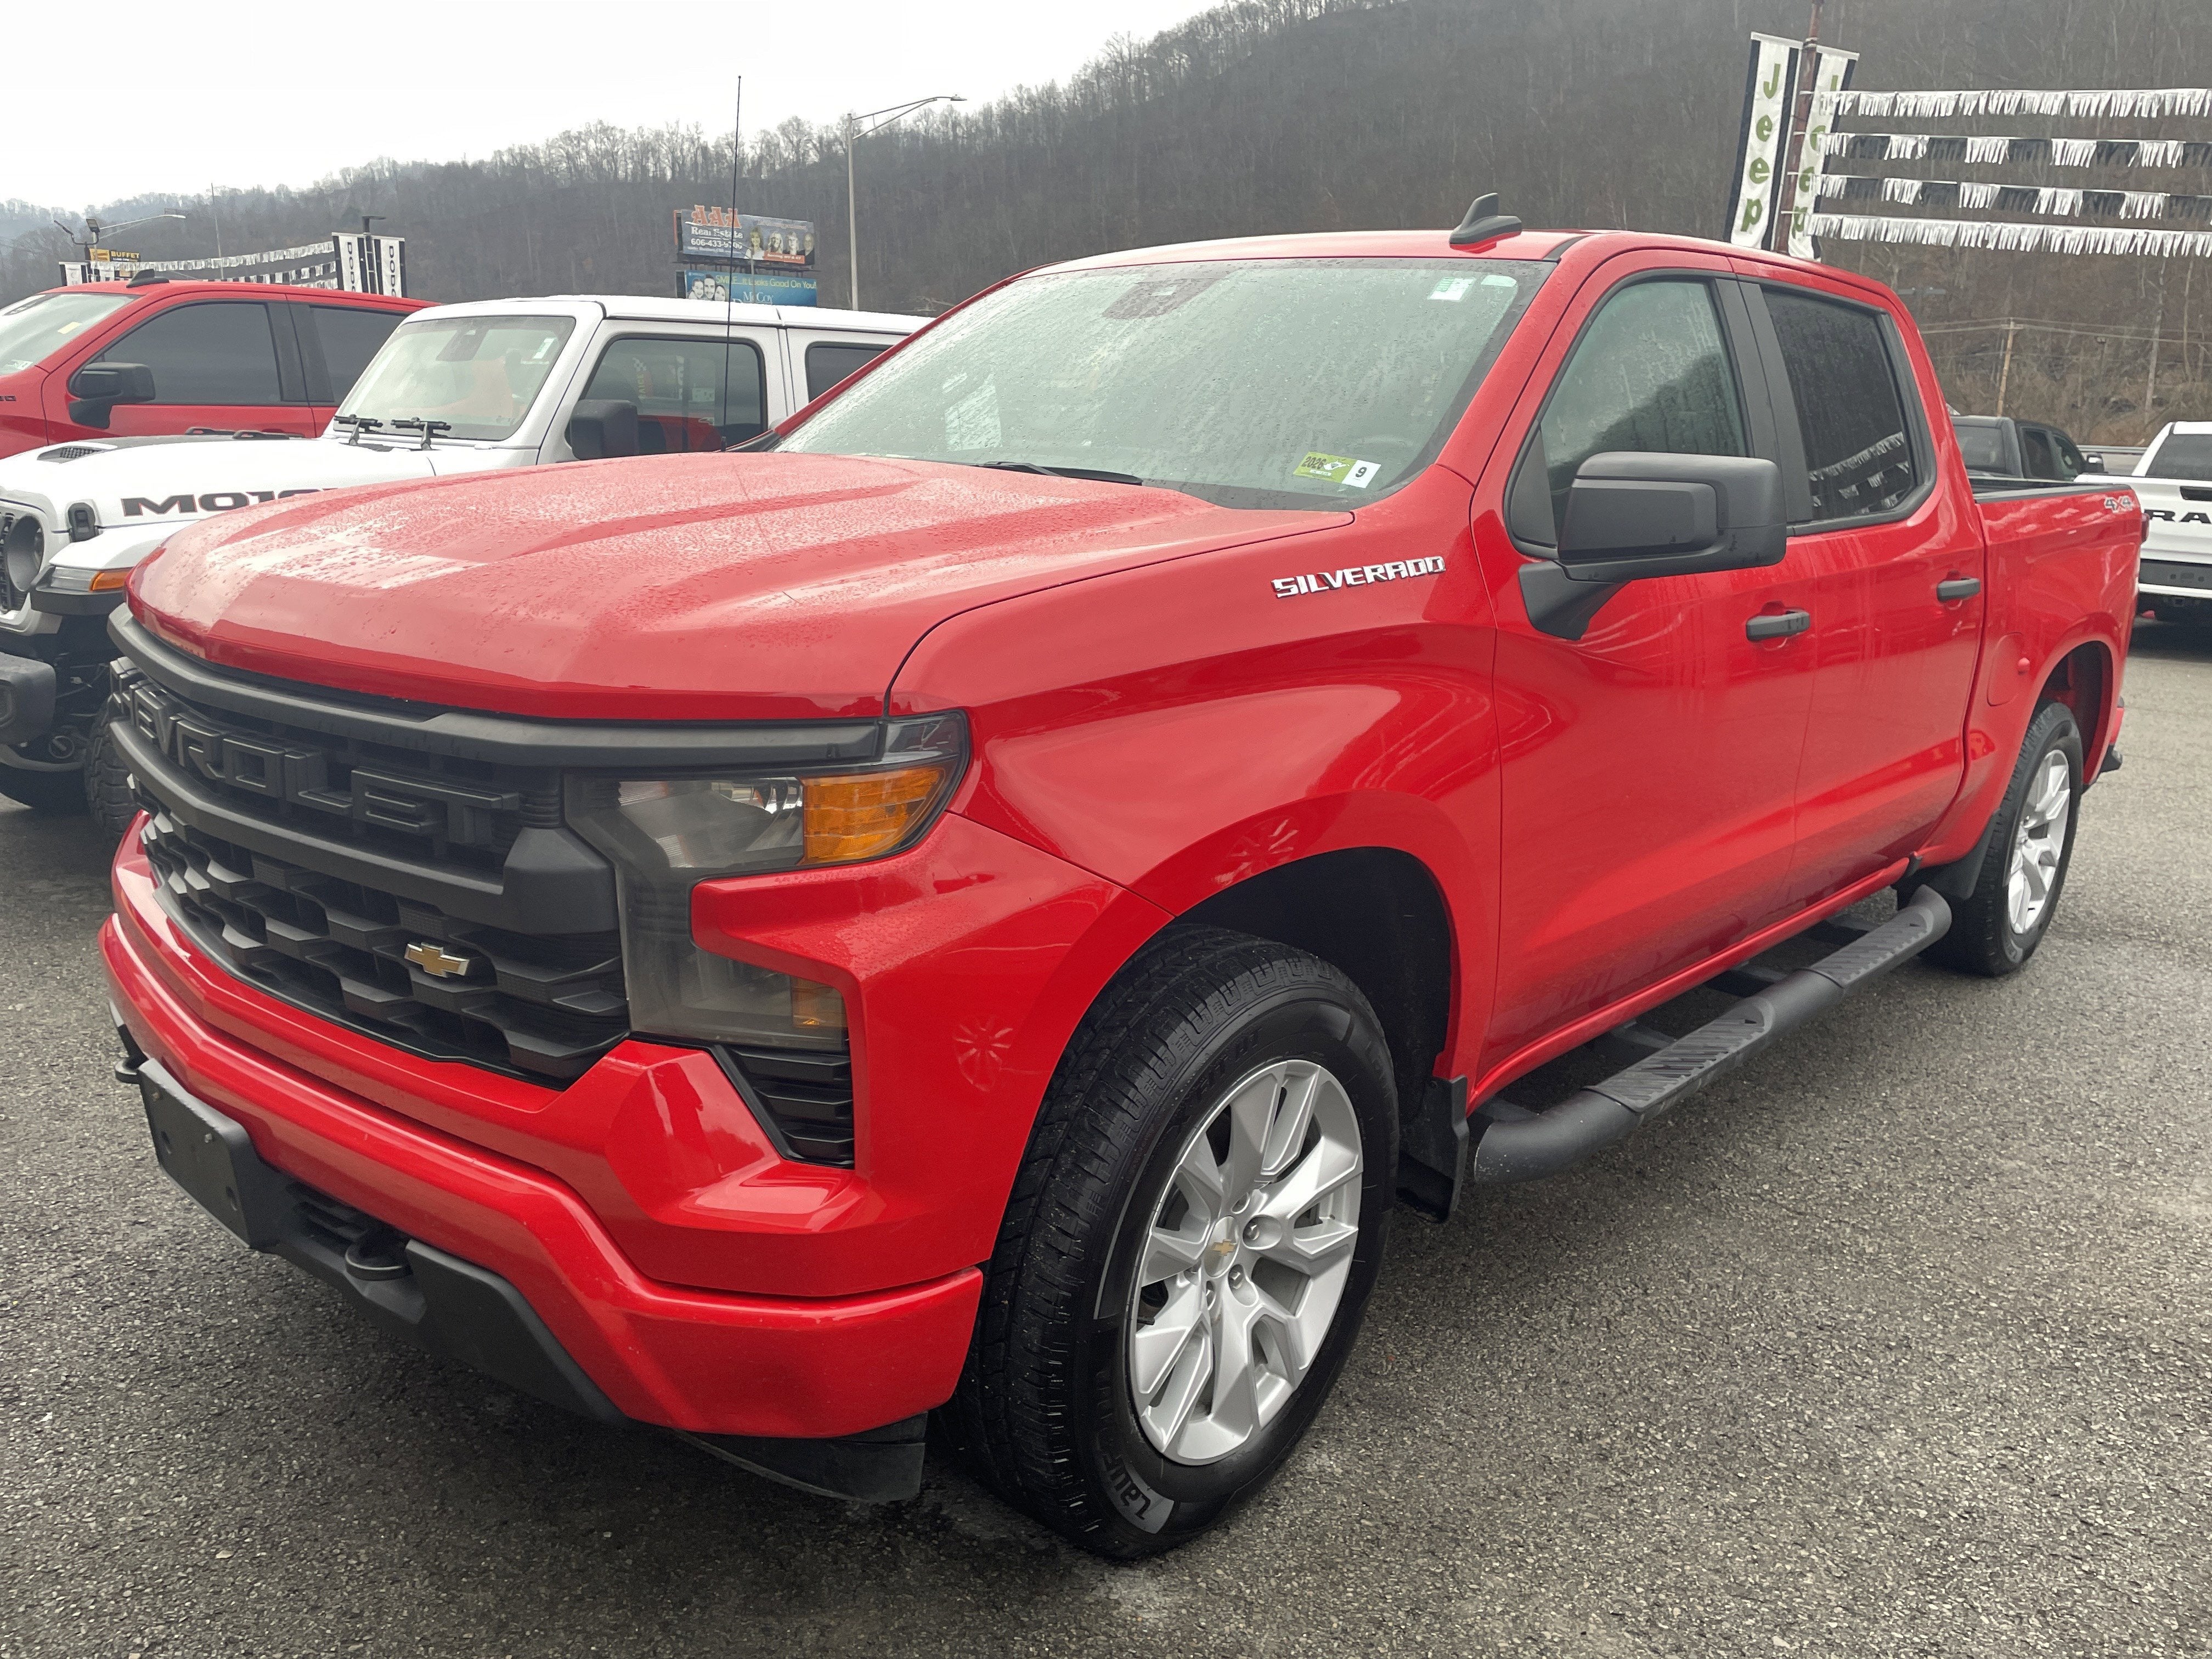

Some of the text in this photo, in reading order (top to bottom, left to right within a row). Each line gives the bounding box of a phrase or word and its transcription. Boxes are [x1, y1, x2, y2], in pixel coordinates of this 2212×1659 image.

[1740, 63, 1781, 233] Jeep
[111, 251, 140, 259] BUFFET
[769, 279, 789, 287] Good
[743, 291, 774, 304] MCoy
[1301, 456, 1327, 469] 2026
[1355, 467, 1367, 478] 9
[1271, 555, 1446, 599] SILVERADO
